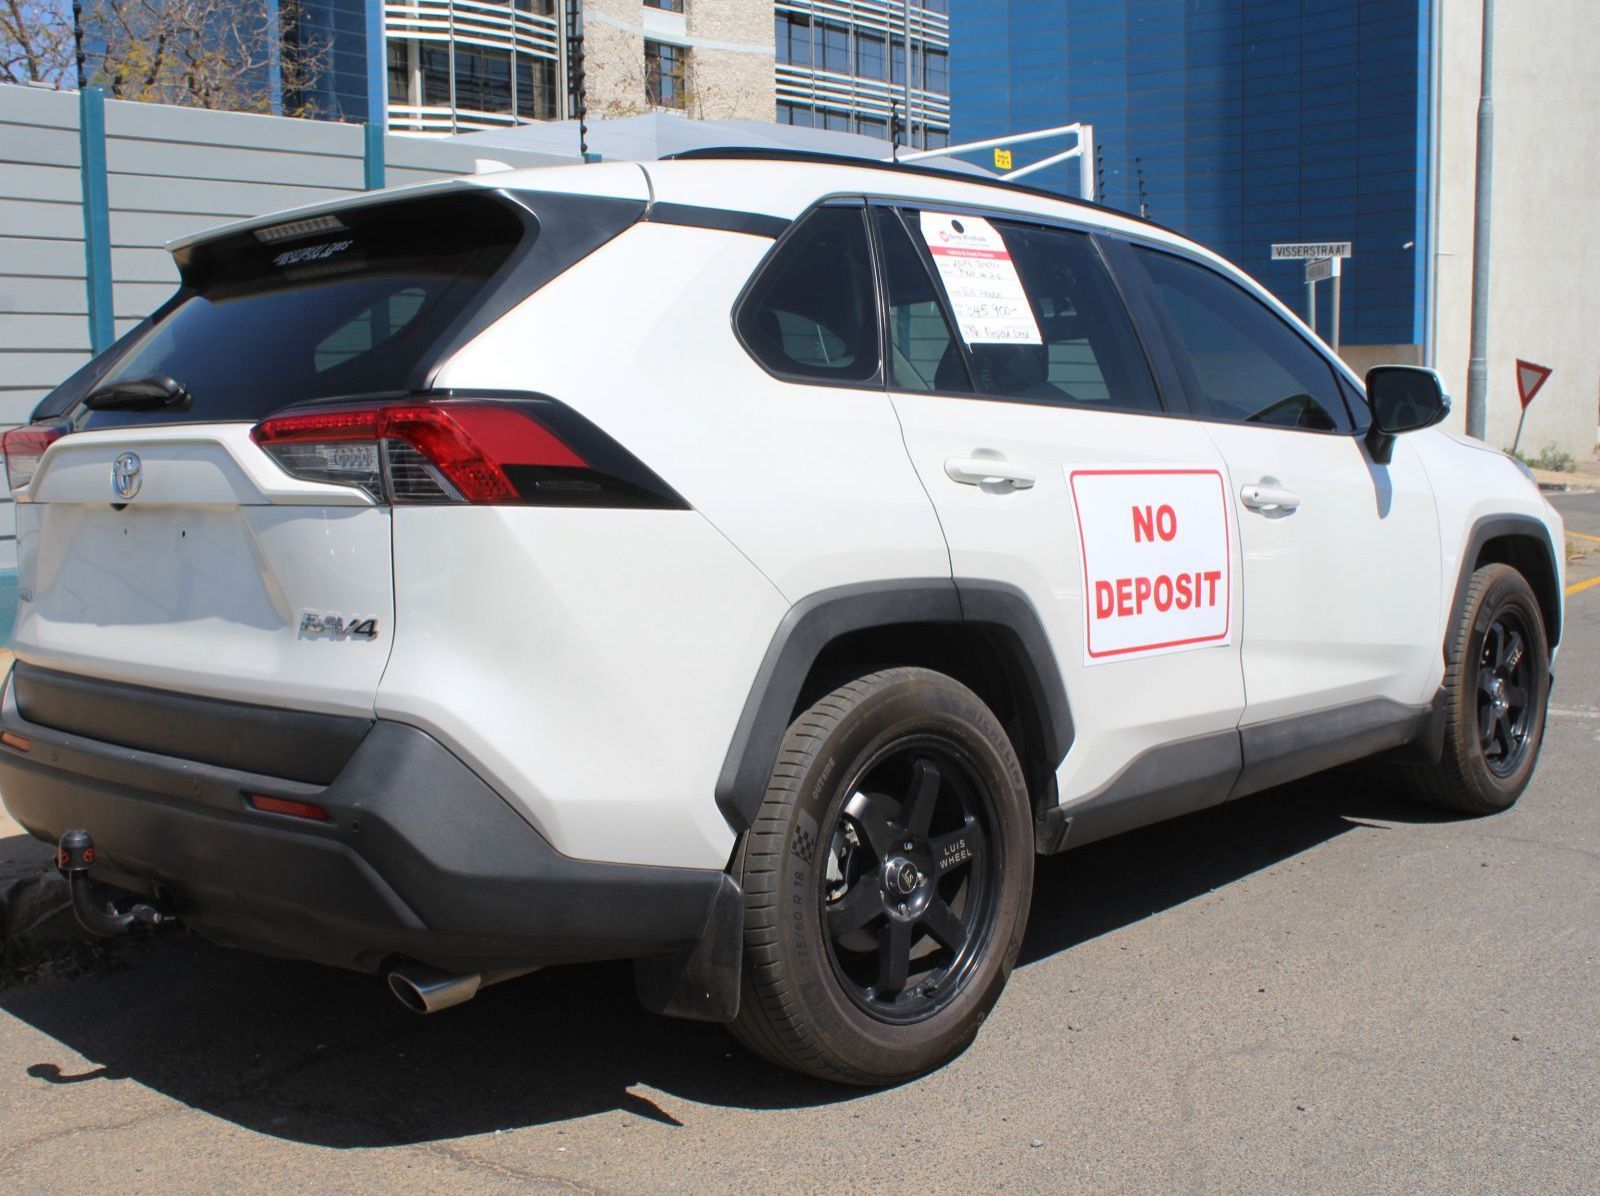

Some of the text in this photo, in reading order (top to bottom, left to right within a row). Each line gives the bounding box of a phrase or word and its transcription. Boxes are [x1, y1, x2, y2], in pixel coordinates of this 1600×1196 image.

[1276, 244, 1347, 258] VISSERSTRAAT
[1132, 504, 1177, 543] NO
[1095, 571, 1221, 620] DEPOSIT
[944, 839, 966, 856] LUIS
[940, 848, 972, 869] WHEEL
